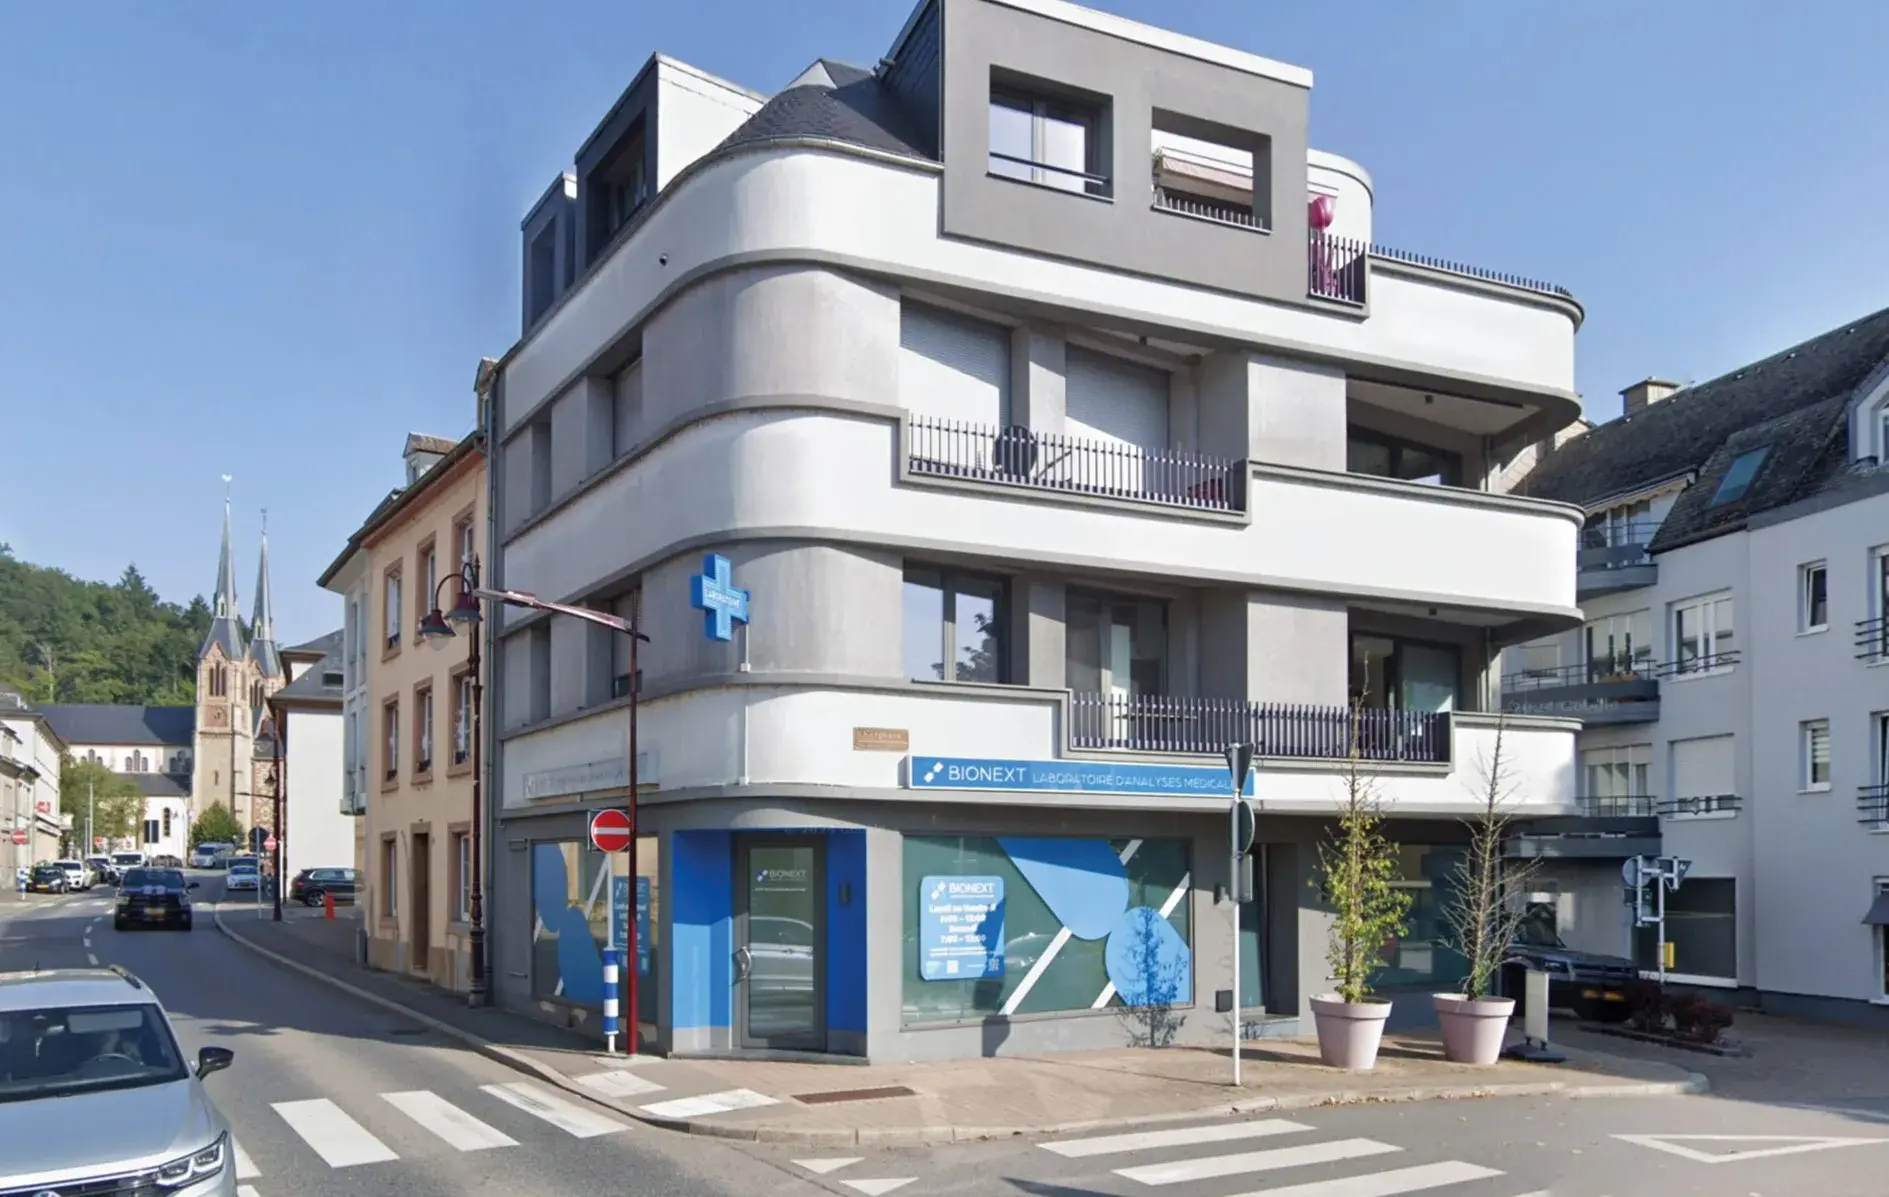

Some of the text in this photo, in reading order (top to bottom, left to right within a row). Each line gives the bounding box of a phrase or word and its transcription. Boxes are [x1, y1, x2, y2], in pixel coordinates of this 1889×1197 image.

[948, 765, 1027, 783] BIONEXT
[1032, 771, 1113, 786] LABORATOIRE
[769, 868, 807, 878] BIONEXT
[949, 882, 995, 894] BIONEXT
